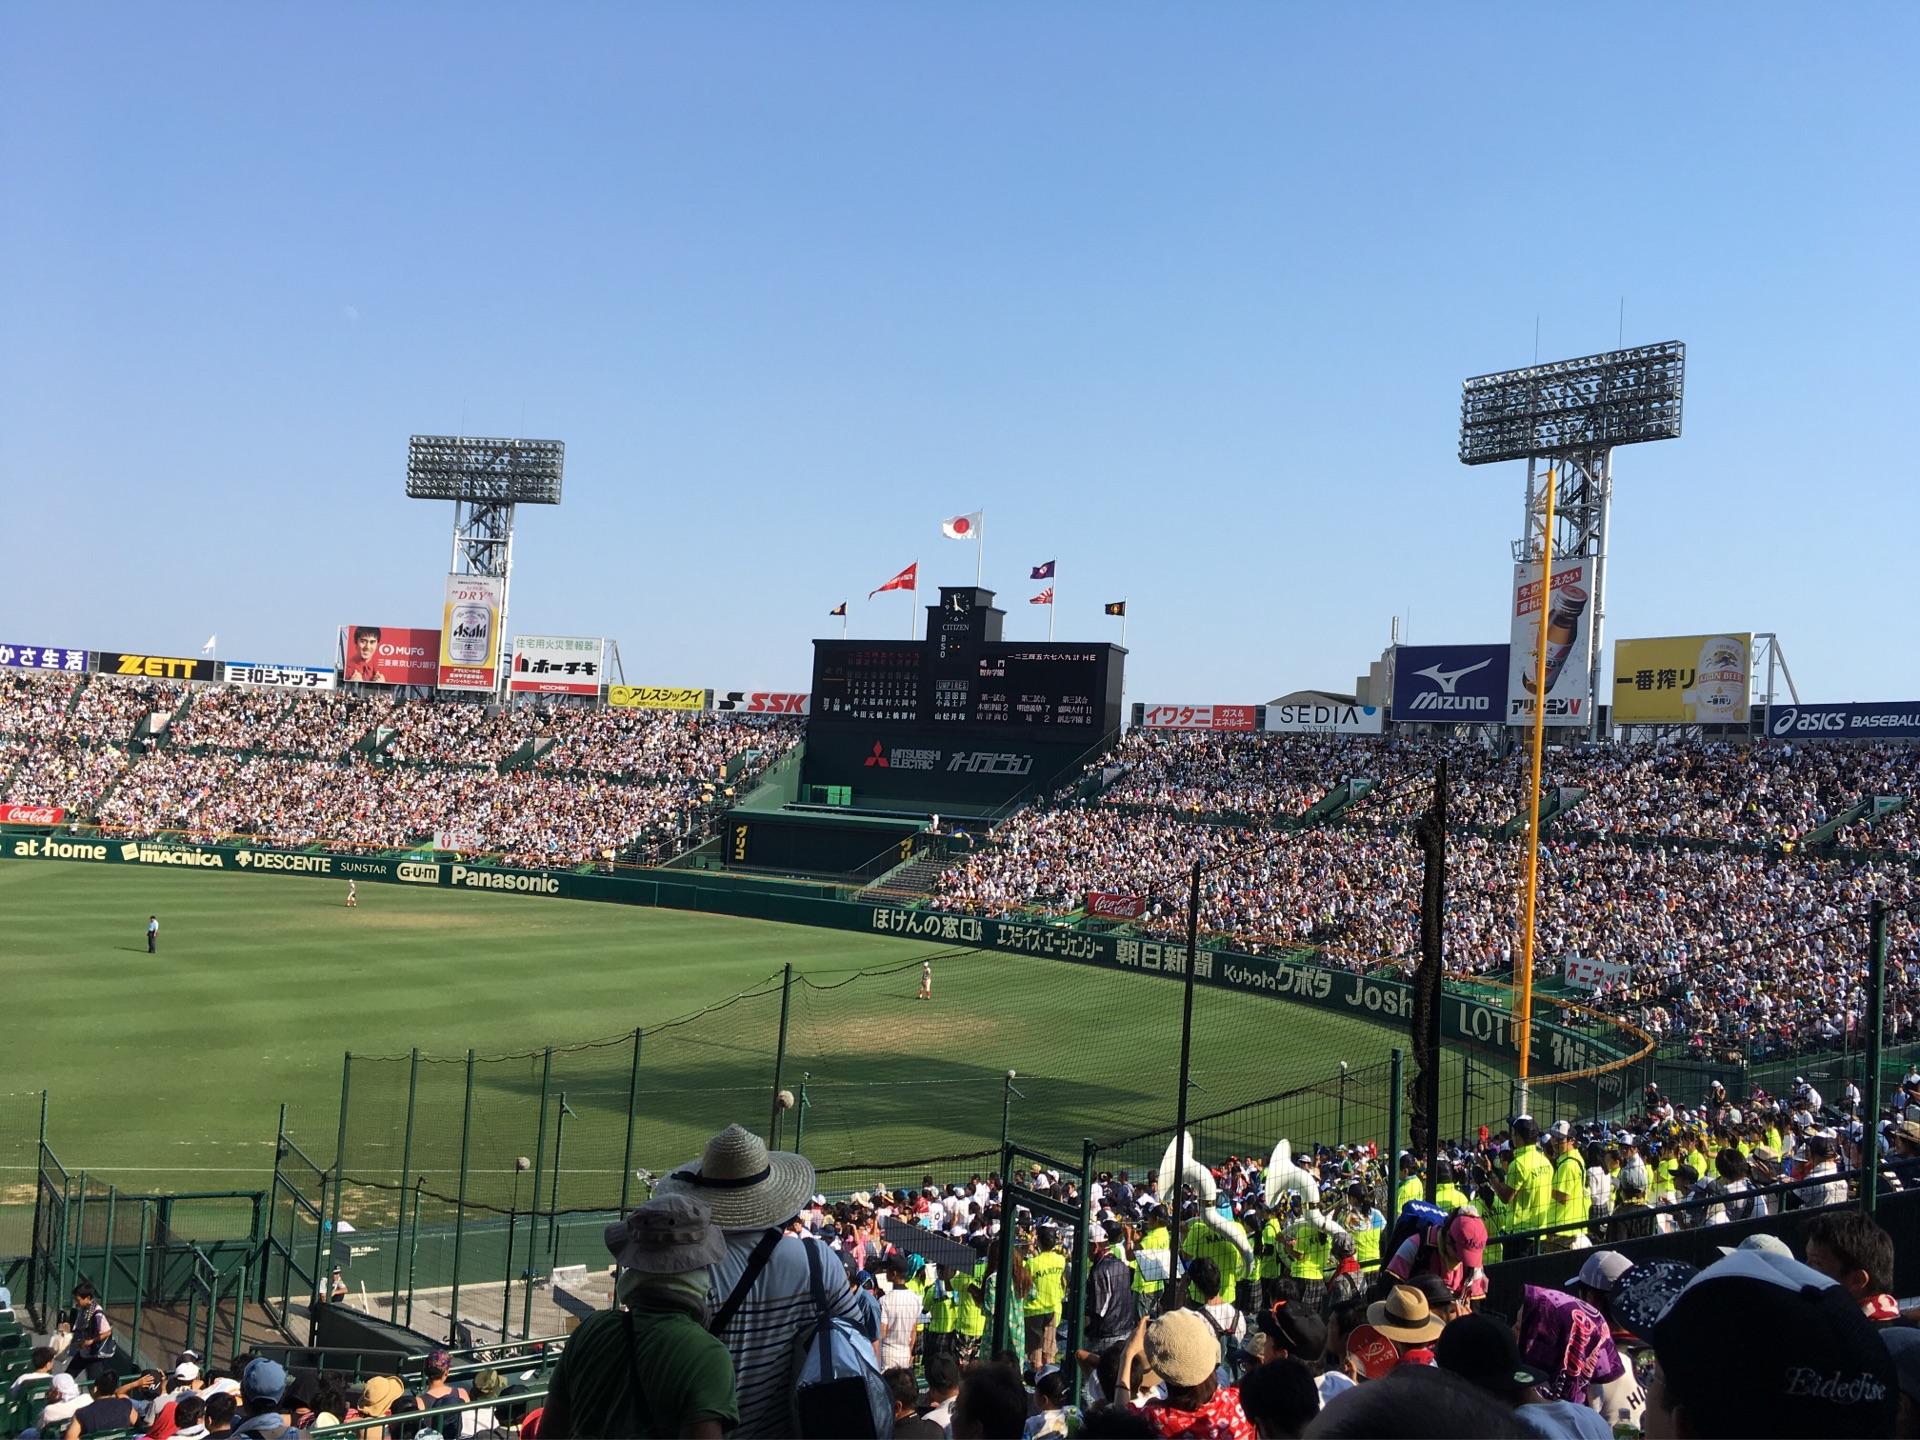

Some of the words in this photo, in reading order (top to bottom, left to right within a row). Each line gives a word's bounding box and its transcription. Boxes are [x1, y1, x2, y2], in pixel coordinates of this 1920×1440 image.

[453, 622, 487, 638] Asahi
[395, 646, 425, 656] MUFG
[117, 655, 197, 678] ZETT
[531, 659, 598, 676] ホーチキ
[231, 668, 327, 687] 三和シャッター
[1616, 668, 1696, 691] 一番搾り
[630, 688, 703, 703] アレスシックイ
[747, 692, 809, 713] SSK
[1146, 706, 1211, 725] イワタニ
[1214, 718, 1252, 727] エネルギー
[891, 748, 941, 760] MITSUBISHI
[890, 759, 934, 770] ELECTRIC
[14, 839, 39, 856] at
[40, 837, 107, 860] home
[735, 825, 748, 860] グリコ
[254, 853, 331, 873] DESCENTE
[340, 861, 387, 875] SUNSTAR
[452, 866, 559, 894] Panasonic
[872, 907, 975, 942] ほけんの窓口
[1115, 939, 1213, 978] 朝日新聞
[1346, 978, 1414, 1019] Josh
